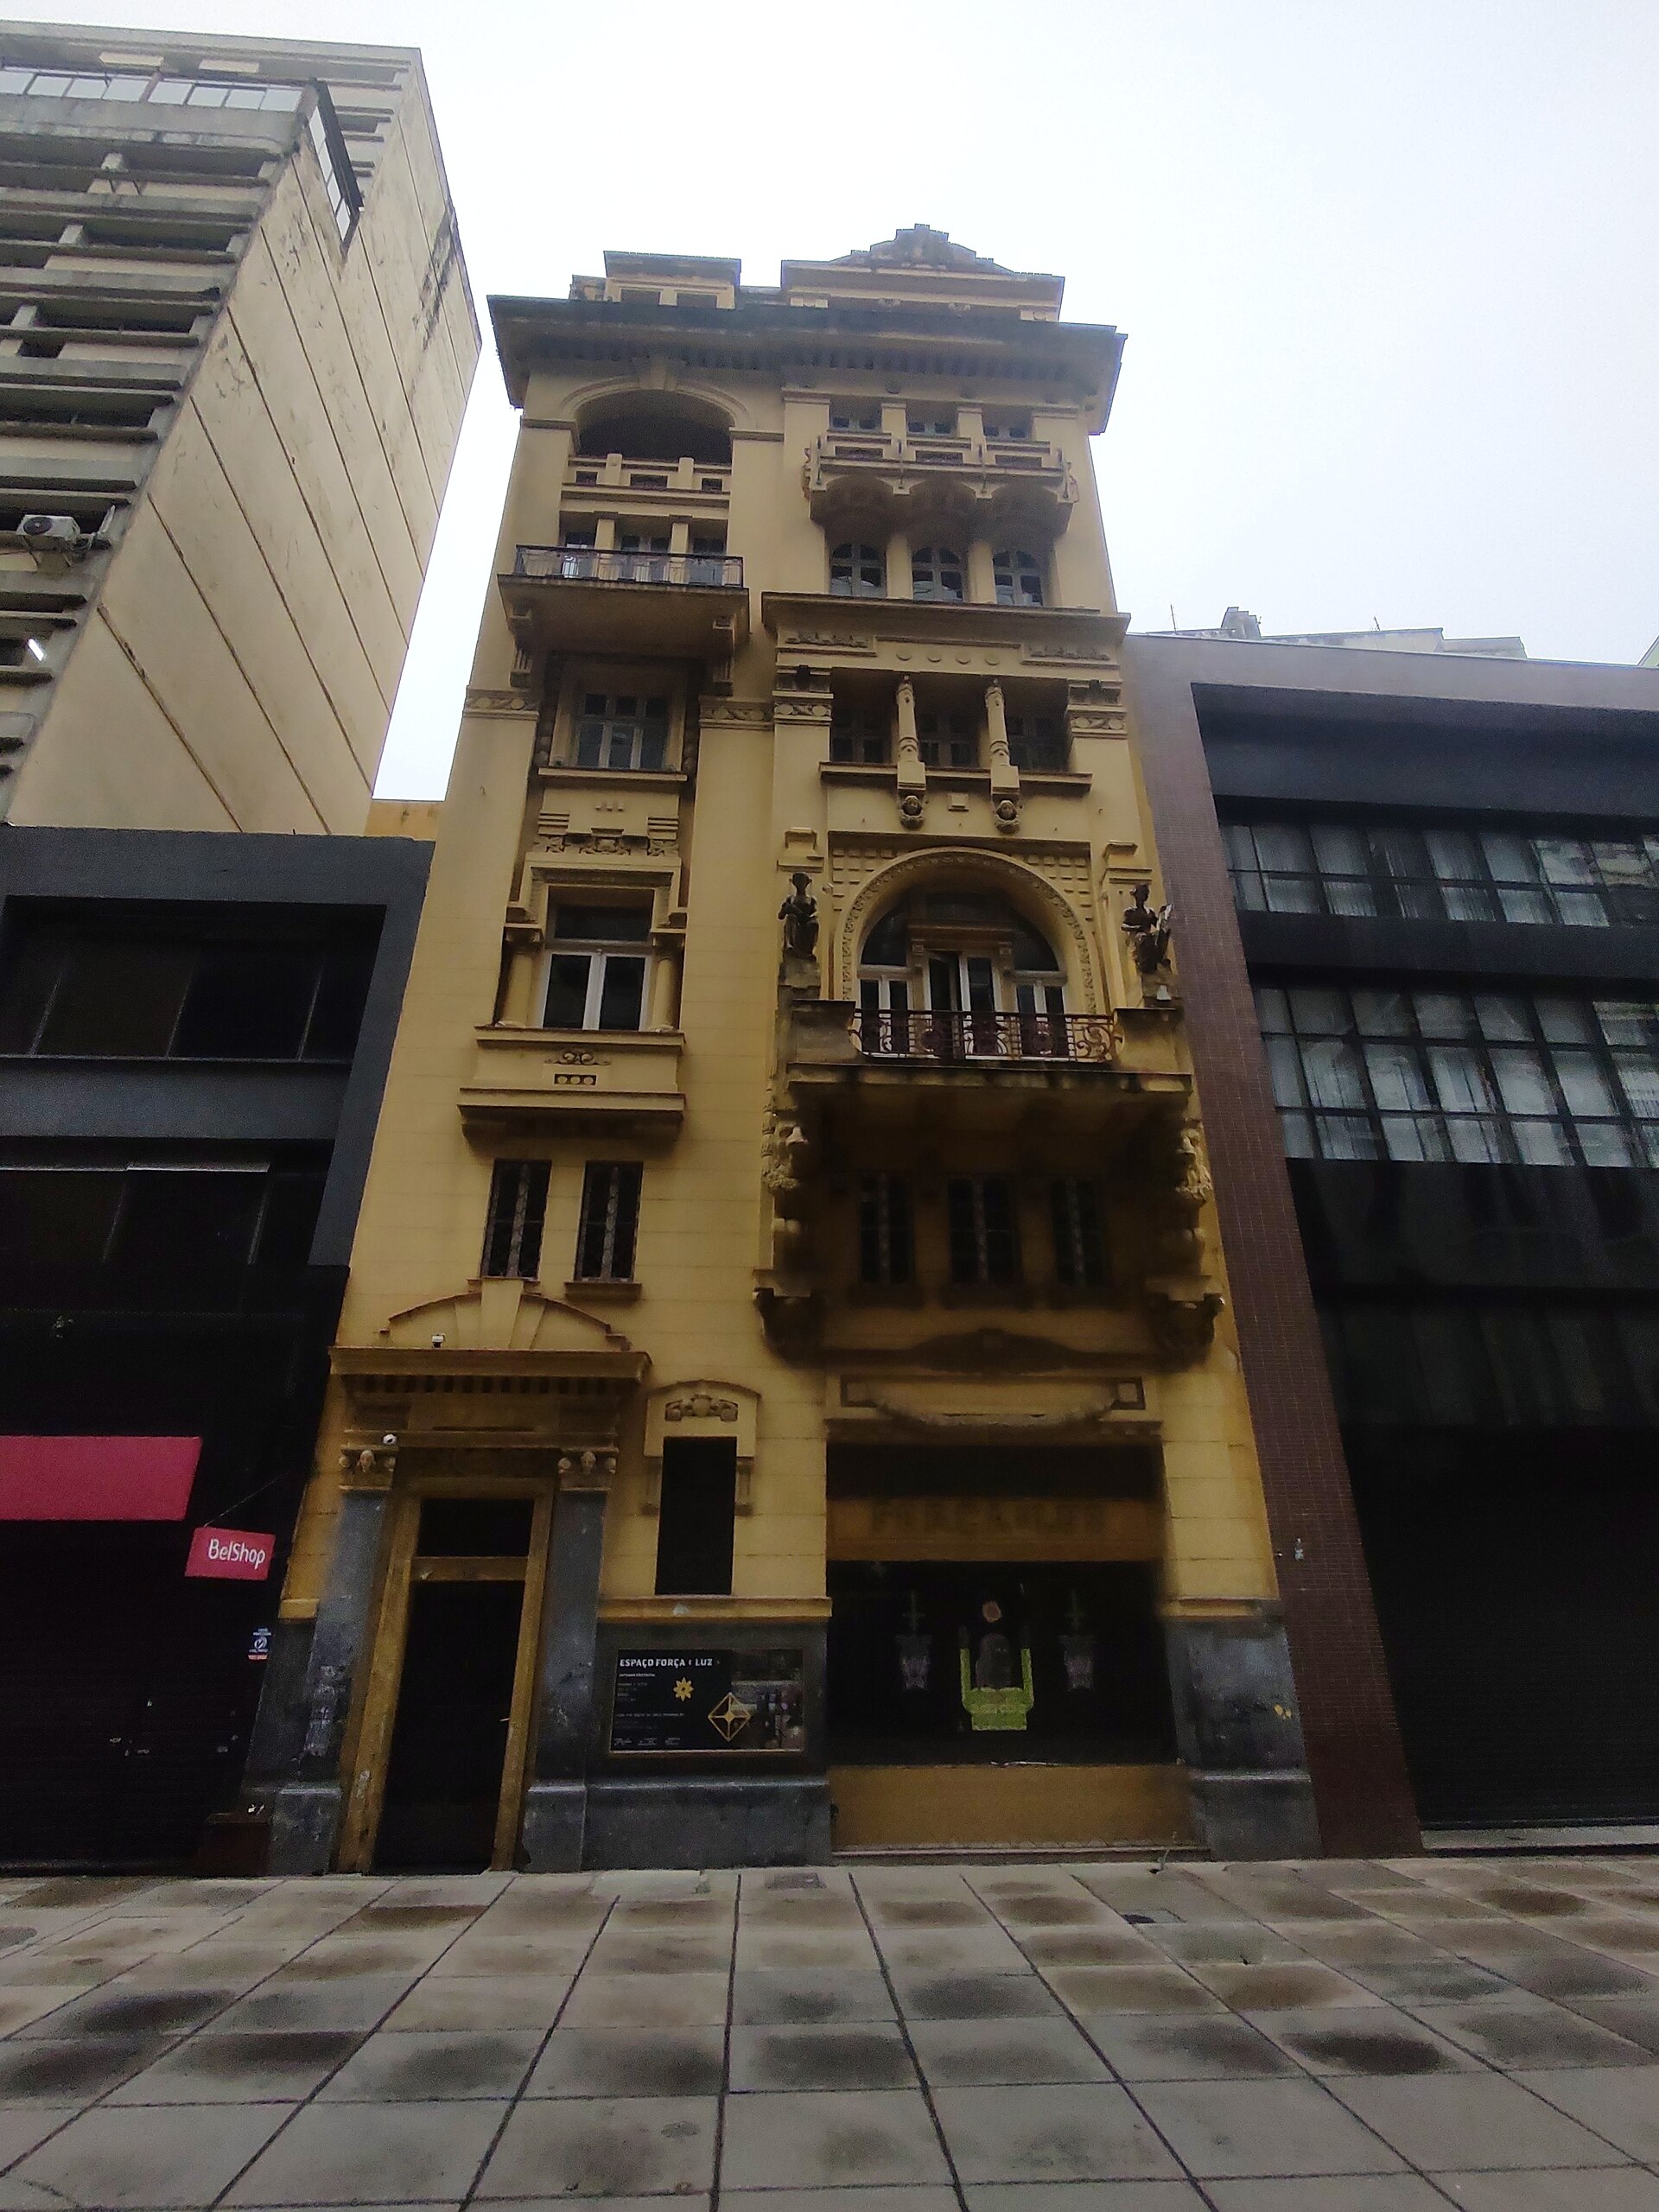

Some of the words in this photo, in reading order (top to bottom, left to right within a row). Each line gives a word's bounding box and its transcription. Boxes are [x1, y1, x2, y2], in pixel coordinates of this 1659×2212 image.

[208, 1538, 266, 1570] BelShop
[619, 1658, 654, 1669] ESPAÇO
[655, 1658, 686, 1669] FORÇA
[695, 1658, 714, 1667] LUZ
